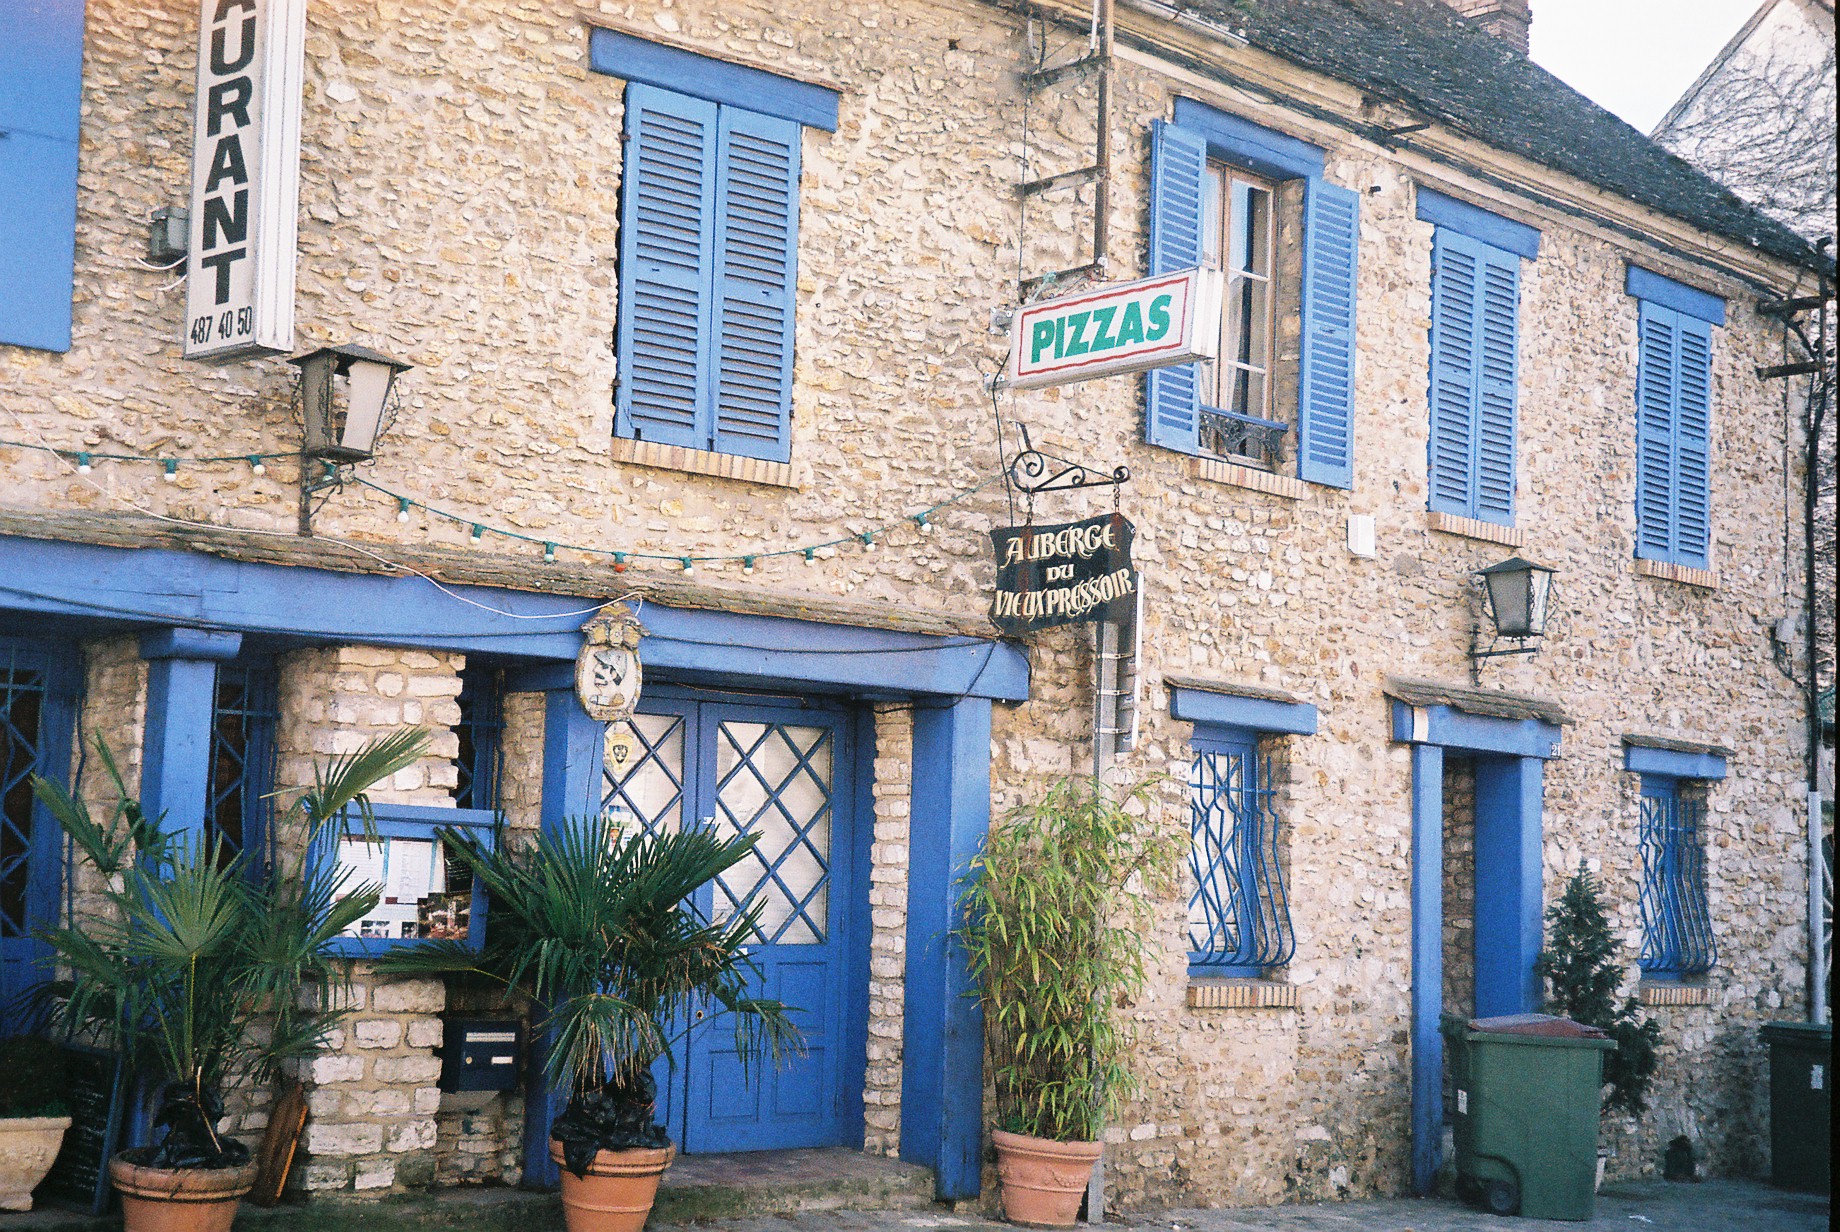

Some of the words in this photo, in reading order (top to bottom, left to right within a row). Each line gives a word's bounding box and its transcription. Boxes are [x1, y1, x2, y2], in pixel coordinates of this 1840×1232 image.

[191, 316, 213, 344] 487
[218, 310, 233, 339] 40
[237, 306, 253, 335] 50
[1031, 294, 1172, 364] PIZZAS
[1000, 523, 1120, 569] AUBERGE
[994, 587, 1048, 623] VIEUX
[1045, 567, 1136, 618] PRESSOIR
[1046, 563, 1075, 582] DU
